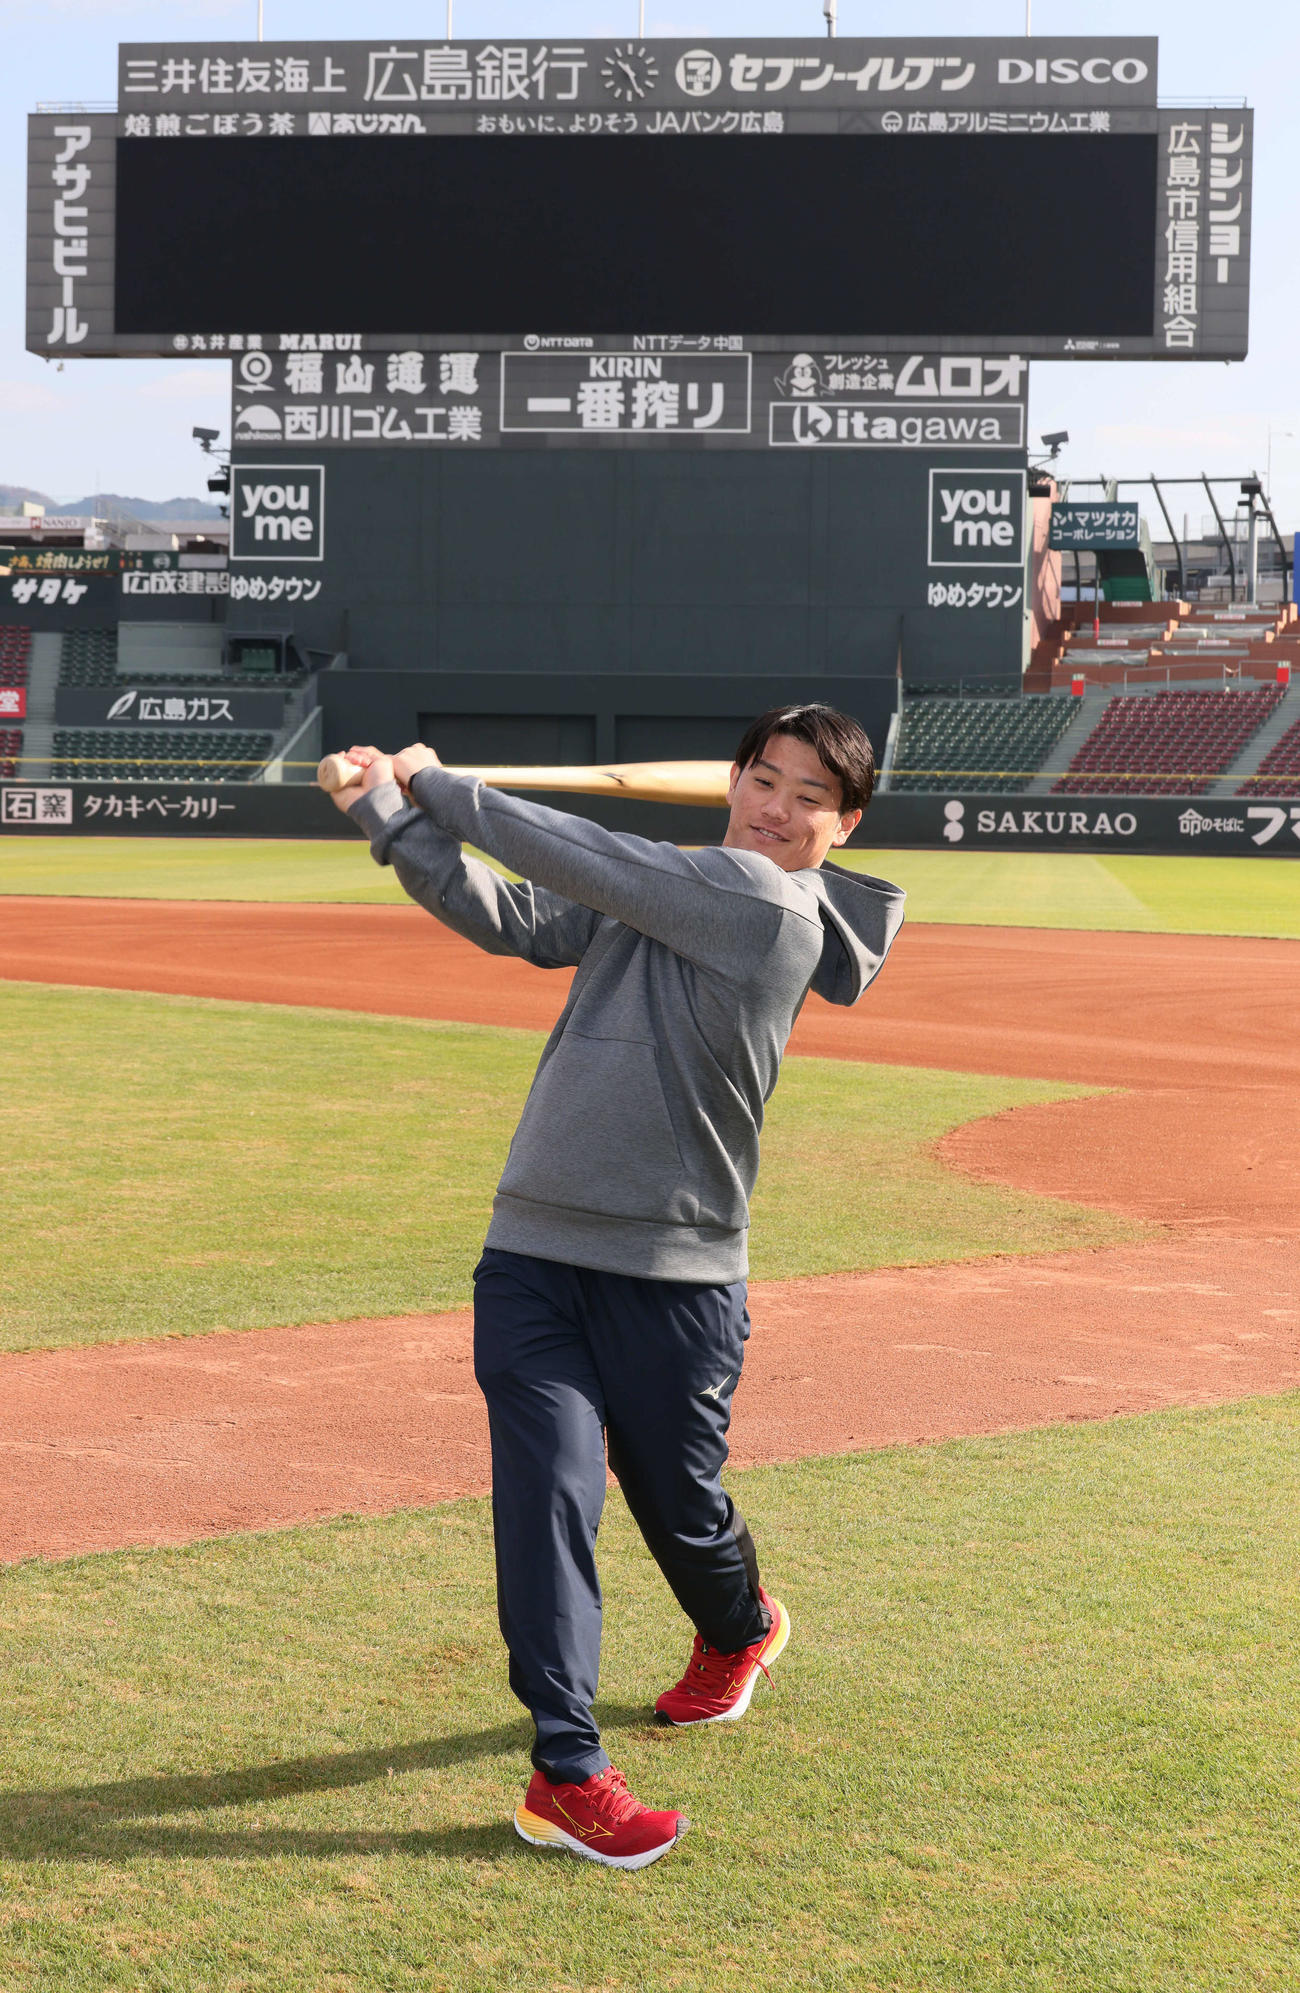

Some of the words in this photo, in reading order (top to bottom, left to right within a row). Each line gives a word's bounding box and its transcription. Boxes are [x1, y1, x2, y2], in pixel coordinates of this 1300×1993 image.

[124, 57, 347, 94] 三井住友海上
[363, 45, 588, 101] 広島銀行
[998, 58, 1148, 84] DISCO
[124, 113, 295, 137] 焙煎ごぼう茶
[476, 112, 638, 134] おもいに、よりそう
[646, 111, 784, 133] JAバンク広島
[907, 111, 1110, 133] 広島アルミニウム工業
[1208, 123, 1244, 283] シシンヨー
[47, 126, 92, 344] アサヒビール
[1163, 122, 1202, 348] 広島市信用組合
[279, 334, 362, 350] MARUI
[285, 352, 479, 394] 福山通運
[589, 357, 662, 377] KIRIN
[824, 355, 888, 370] フレッシュ
[894, 355, 1028, 396] ムロオ
[527, 381, 724, 428] 一番搾り
[284, 405, 482, 440] 西川ゴム工業
[241, 485, 309, 518] you
[940, 489, 1011, 523] you
[254, 515, 313, 541] me
[1075, 510, 1136, 527] マツオカ
[953, 520, 1014, 546] me
[1053, 528, 1136, 541] コーポレーション
[11, 577, 88, 605] サタケ
[122, 571, 230, 595] 広成建設
[230, 575, 322, 601] ゆめタウン
[928, 582, 1023, 608] ゆめタウン
[138, 697, 234, 721] 広島ガス
[83, 796, 236, 819] タカキベーカリー
[977, 810, 1137, 835] SAKURAO
[1178, 808, 1245, 837] 命のそばに
[1247, 806, 1300, 846] フ
